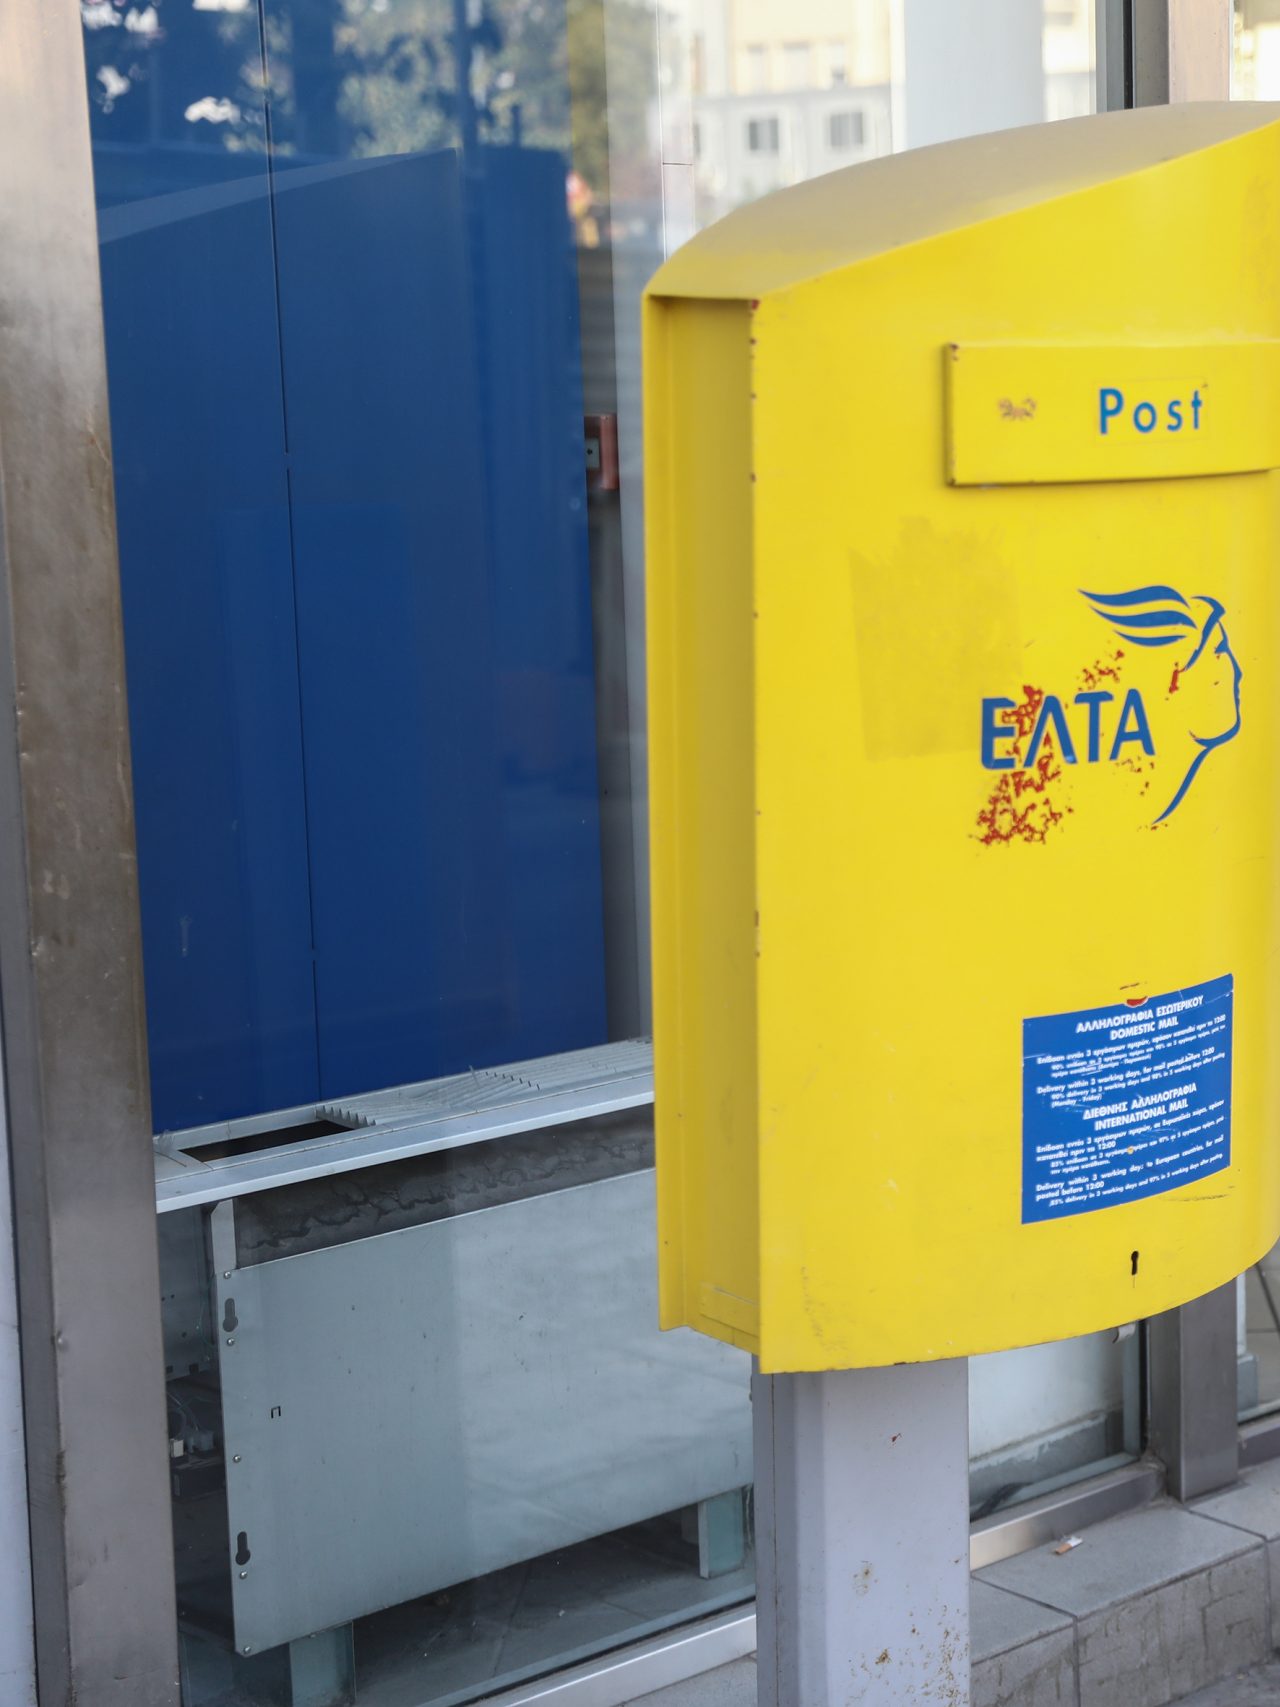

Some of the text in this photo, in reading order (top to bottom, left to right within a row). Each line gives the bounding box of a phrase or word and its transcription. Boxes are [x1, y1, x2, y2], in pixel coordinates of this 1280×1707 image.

[1099, 388, 1203, 434] Post
[981, 689, 1155, 769] ΕΛΤΑ
[1076, 996, 1203, 1033] ΑΛΛΗΛΟΓΡΑΦΙΑ ΕΣΩΤΕΡΙΚΟΥ
[1110, 1017, 1178, 1040] DOMESTIC MAIL
[1036, 1085, 1065, 1095] Delivery
[1067, 1080, 1088, 1088] within
[1097, 1074, 1123, 1083] working
[1153, 1062, 1165, 1071] mail
[1104, 1082, 1125, 1090] working
[1174, 1065, 1191, 1073] working
[1082, 1083, 1196, 1120] ΔΙΕΘΝΗΣ ΑΛΛΗΛΟΓΡΑΦΙΑ
[1094, 1099, 1188, 1130] INTERNATIONAL MAIL
[1098, 1141, 1116, 1149] 12:00
[1036, 1183, 1064, 1191] Delivery
[1067, 1177, 1088, 1185] within
[1100, 1169, 1126, 1178] working
[1214, 1135, 1223, 1143] mail
[1035, 1181, 1104, 1201] posted before 12:00
[1065, 1195, 1087, 1203] delivery
[1102, 1187, 1123, 1195] working
[1138, 1178, 1148, 1186] and
[1171, 1167, 1188, 1175] working
